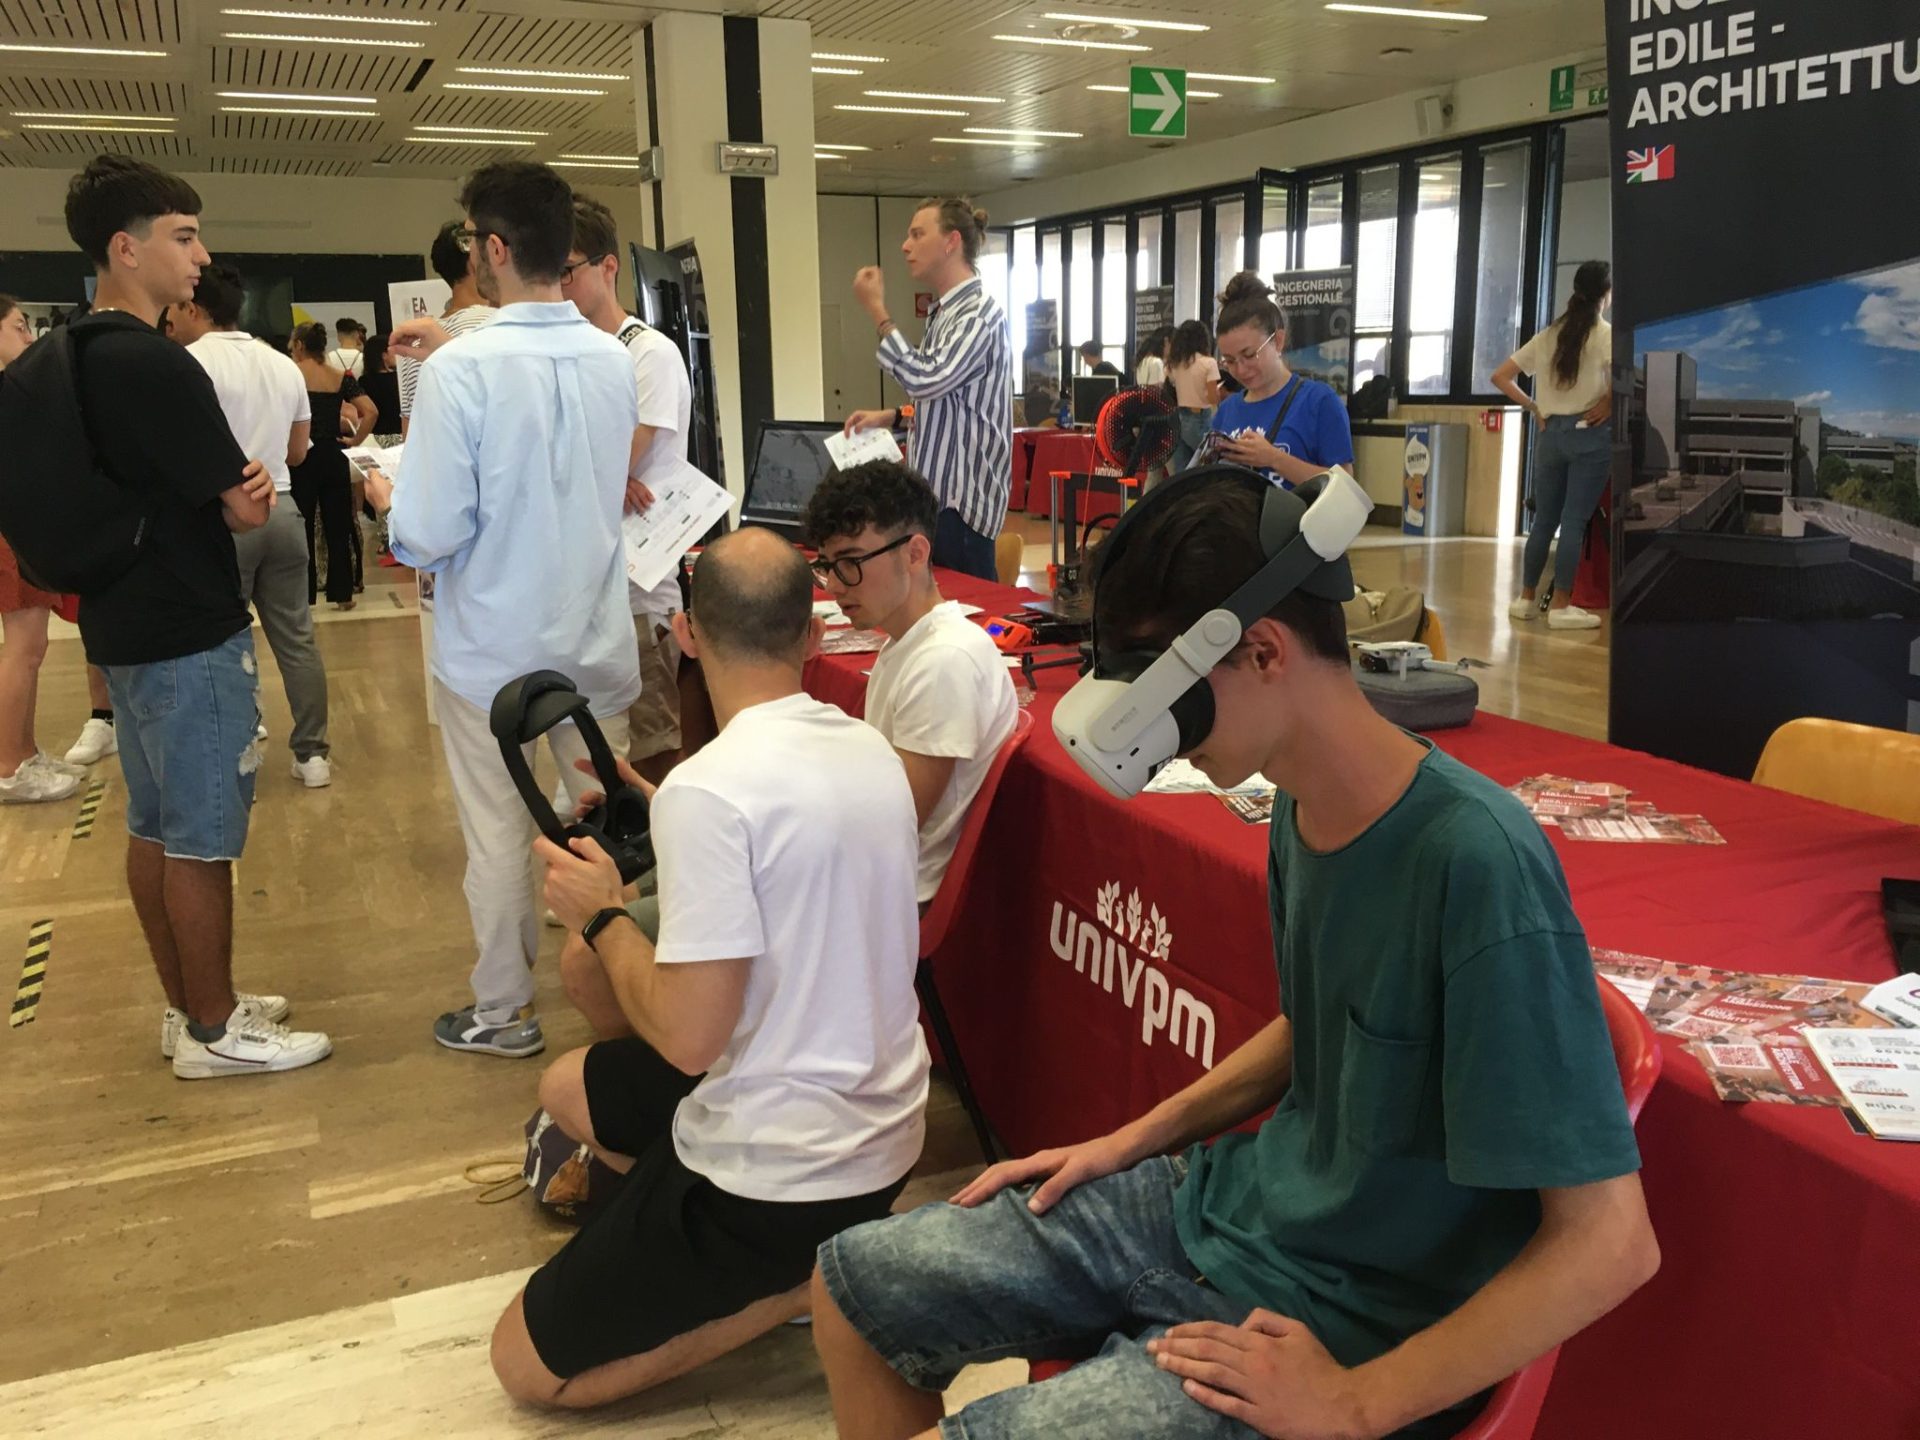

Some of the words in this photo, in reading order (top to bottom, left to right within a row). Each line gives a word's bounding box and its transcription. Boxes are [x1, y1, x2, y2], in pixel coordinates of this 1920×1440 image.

[1630, 11, 1755, 75] EDILE
[1627, 39, 1920, 128] ARCHITETTU
[1277, 278, 1343, 294] INGEGNERIA
[1278, 291, 1343, 306] GESTIONALE
[1050, 901, 1215, 1070] univpm
